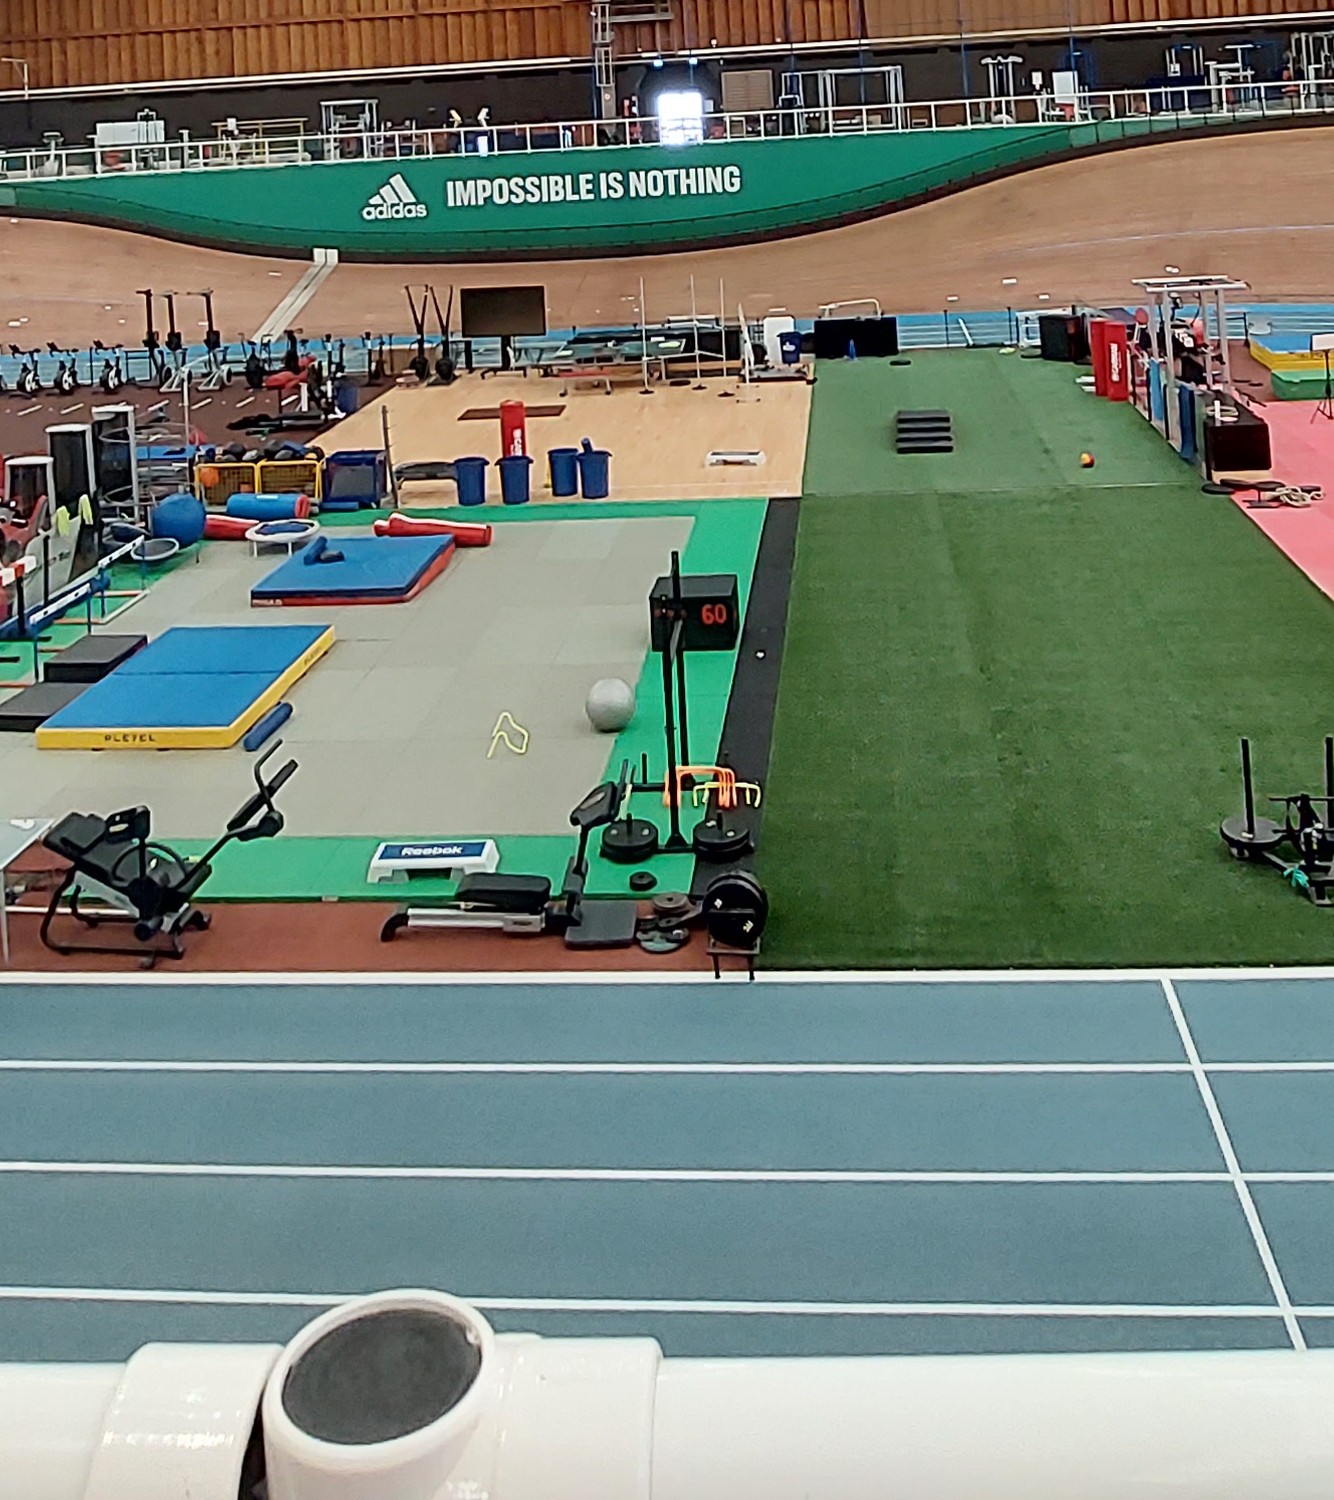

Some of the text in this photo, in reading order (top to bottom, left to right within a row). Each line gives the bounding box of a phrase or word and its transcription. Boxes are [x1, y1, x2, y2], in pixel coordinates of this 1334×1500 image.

[446, 165, 741, 207] IMPOSSIBLE IS NOTHING
[361, 203, 428, 220] adidas
[701, 604, 727, 625] 60
[401, 846, 464, 857] Reebok
